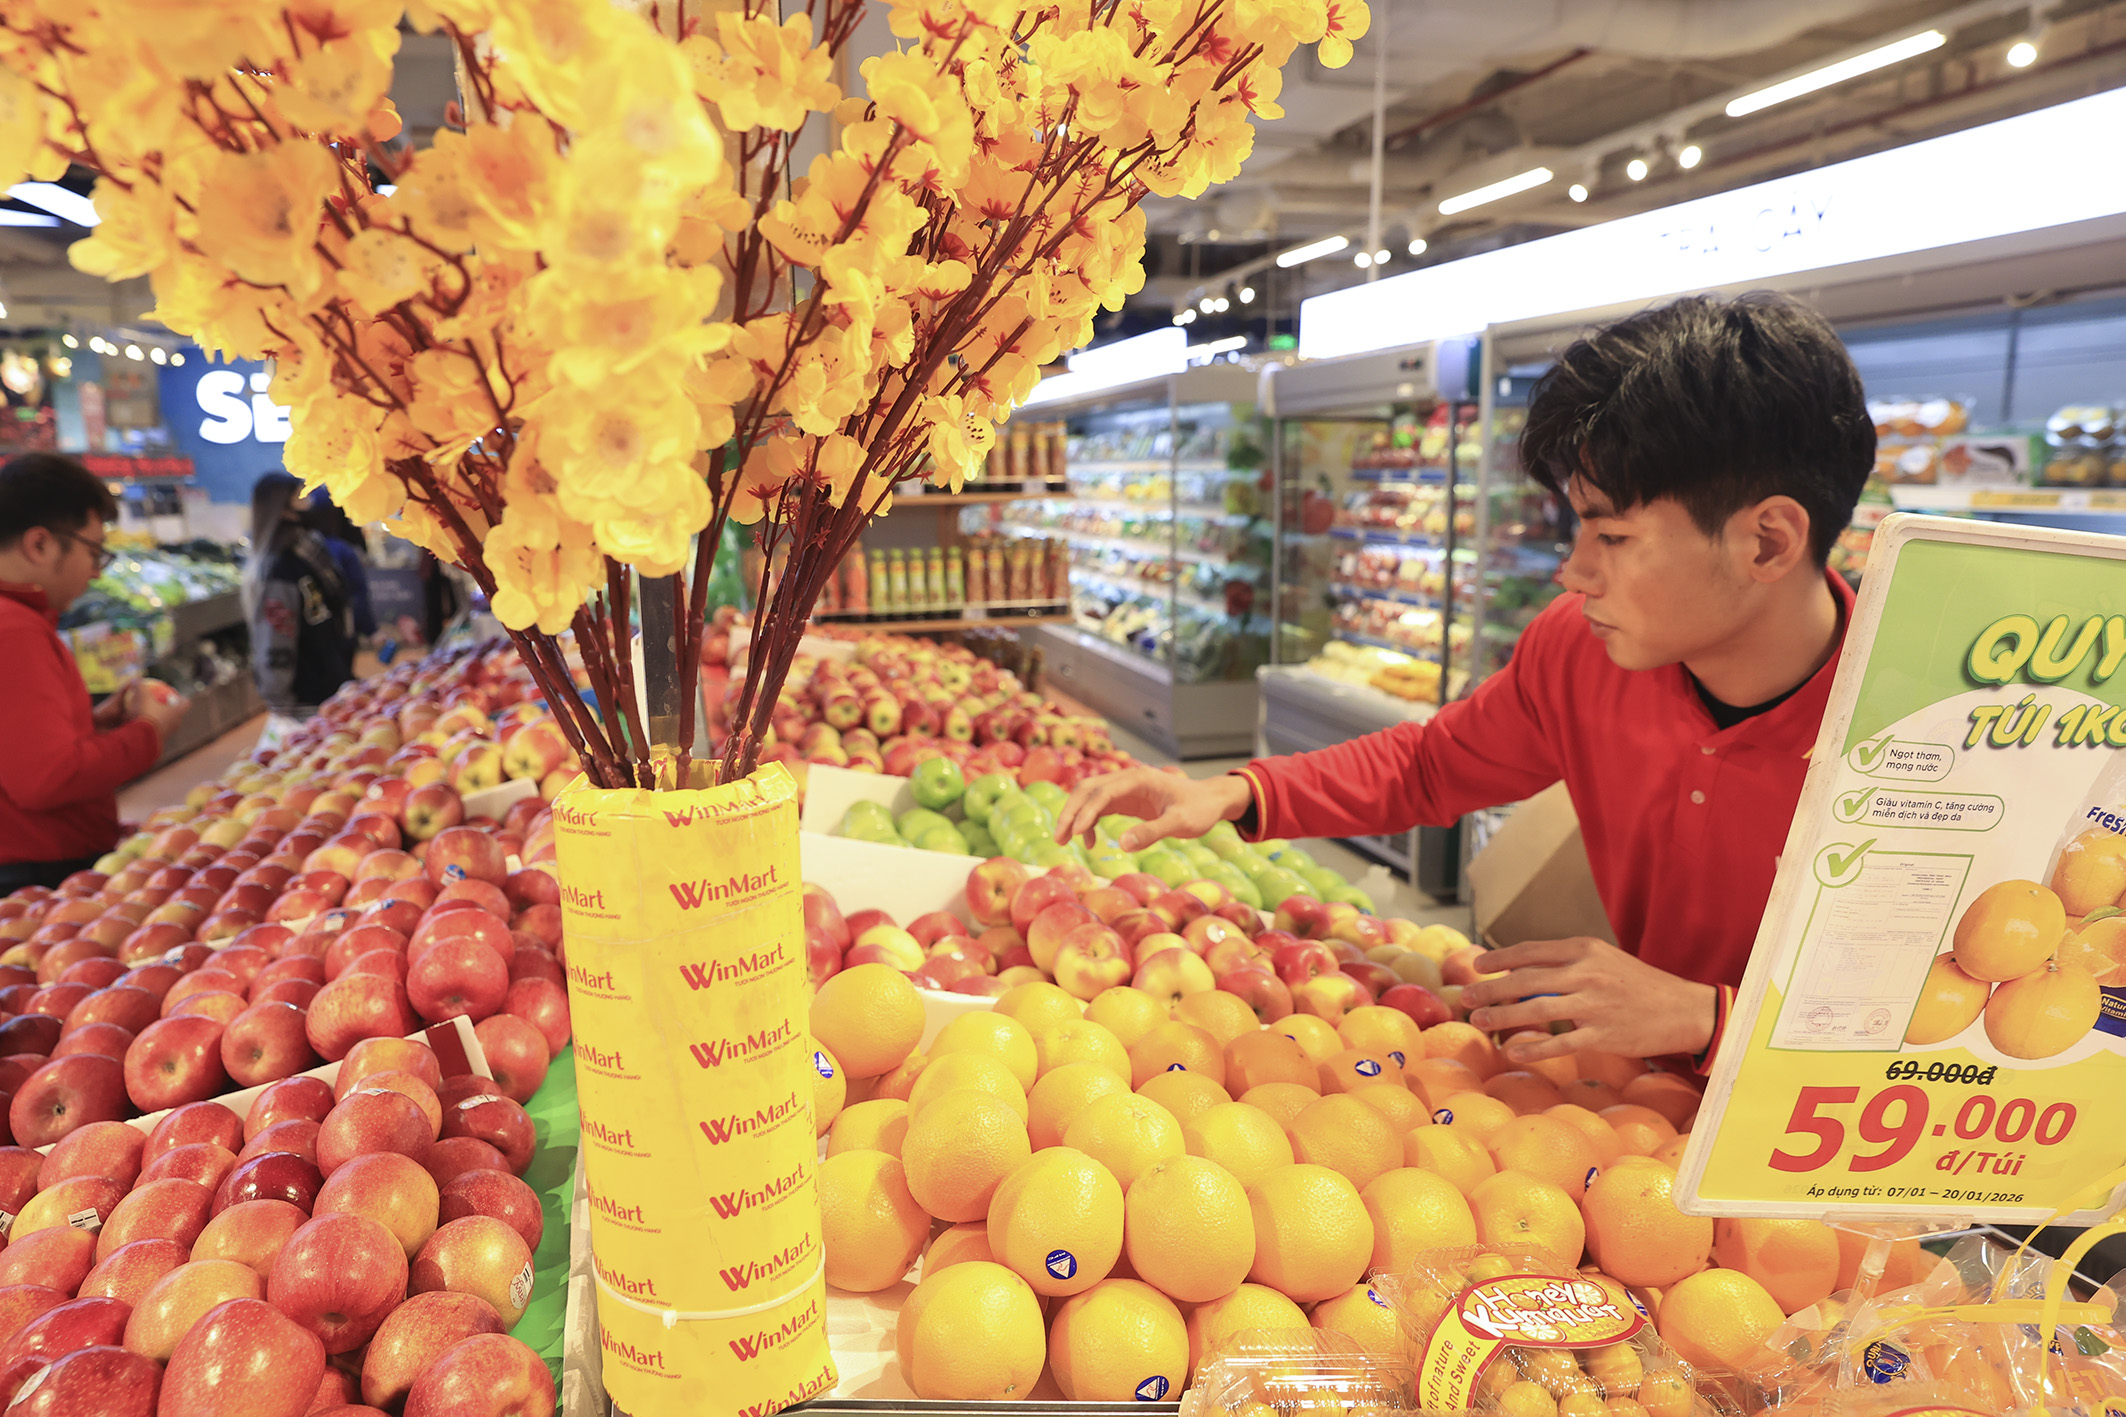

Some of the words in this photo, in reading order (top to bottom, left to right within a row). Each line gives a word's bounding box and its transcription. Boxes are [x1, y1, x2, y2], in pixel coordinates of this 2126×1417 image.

[1965, 692, 2052, 748] TÚI
[1886, 761, 1914, 771] mọng
[1916, 762, 1939, 772] nước
[1889, 749, 1914, 760] Ngọt
[1898, 809, 1917, 821] dịch
[1931, 811, 1948, 822] đẹp
[1950, 812, 1962, 822] da
[1900, 799, 1933, 809] vitamin
[1935, 801, 1944, 810] C,
[1967, 803, 1995, 813] cường
[669, 864, 778, 911] WinMart
[679, 942, 785, 991] WinMart
[689, 1018, 791, 1070] WinMart
[1886, 1060, 1998, 1086] 69.000đ
[699, 1091, 798, 1146] WinMart
[1768, 1084, 2077, 1173] 59.000
[1935, 1150, 2026, 1177] đ/Túi
[709, 1163, 805, 1220] WinMart
[1807, 1183, 1825, 1198] Áp
[1828, 1185, 1859, 1199] dụng
[1862, 1184, 1882, 1196] từ:
[1887, 1186, 1926, 1199] 07/01
[1941, 1188, 2024, 1203] 20/01/2026
[719, 1232, 812, 1292] WinMart
[729, 1299, 818, 1362] WinMart
[1432, 1340, 1454, 1387] nature
[1450, 1340, 1481, 1385] Sweet
[738, 1365, 833, 1417] WinMart
[1427, 1381, 1440, 1402] of
[1444, 1381, 1460, 1411] And
